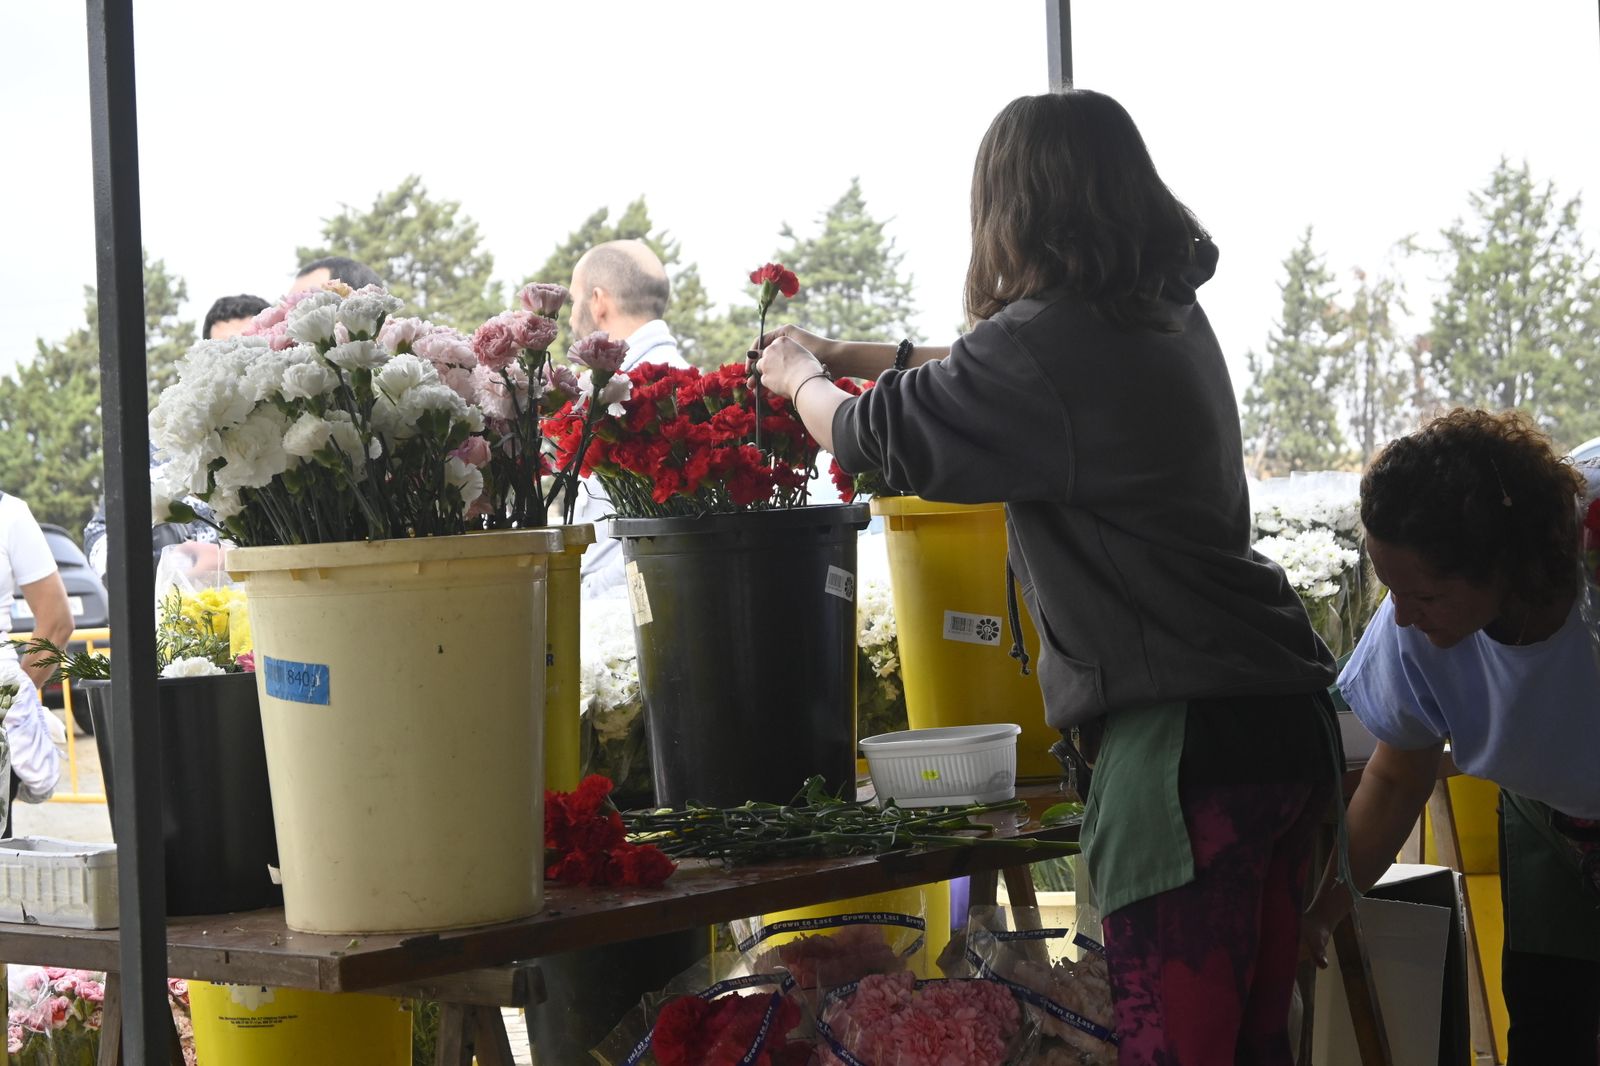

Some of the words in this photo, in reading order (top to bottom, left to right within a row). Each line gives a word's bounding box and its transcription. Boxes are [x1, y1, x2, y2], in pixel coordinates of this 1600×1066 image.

[773, 921, 799, 930] Grown
[814, 918, 833, 926] Last
[1065, 1011, 1075, 1020] to
[1076, 1016, 1096, 1031] Last
